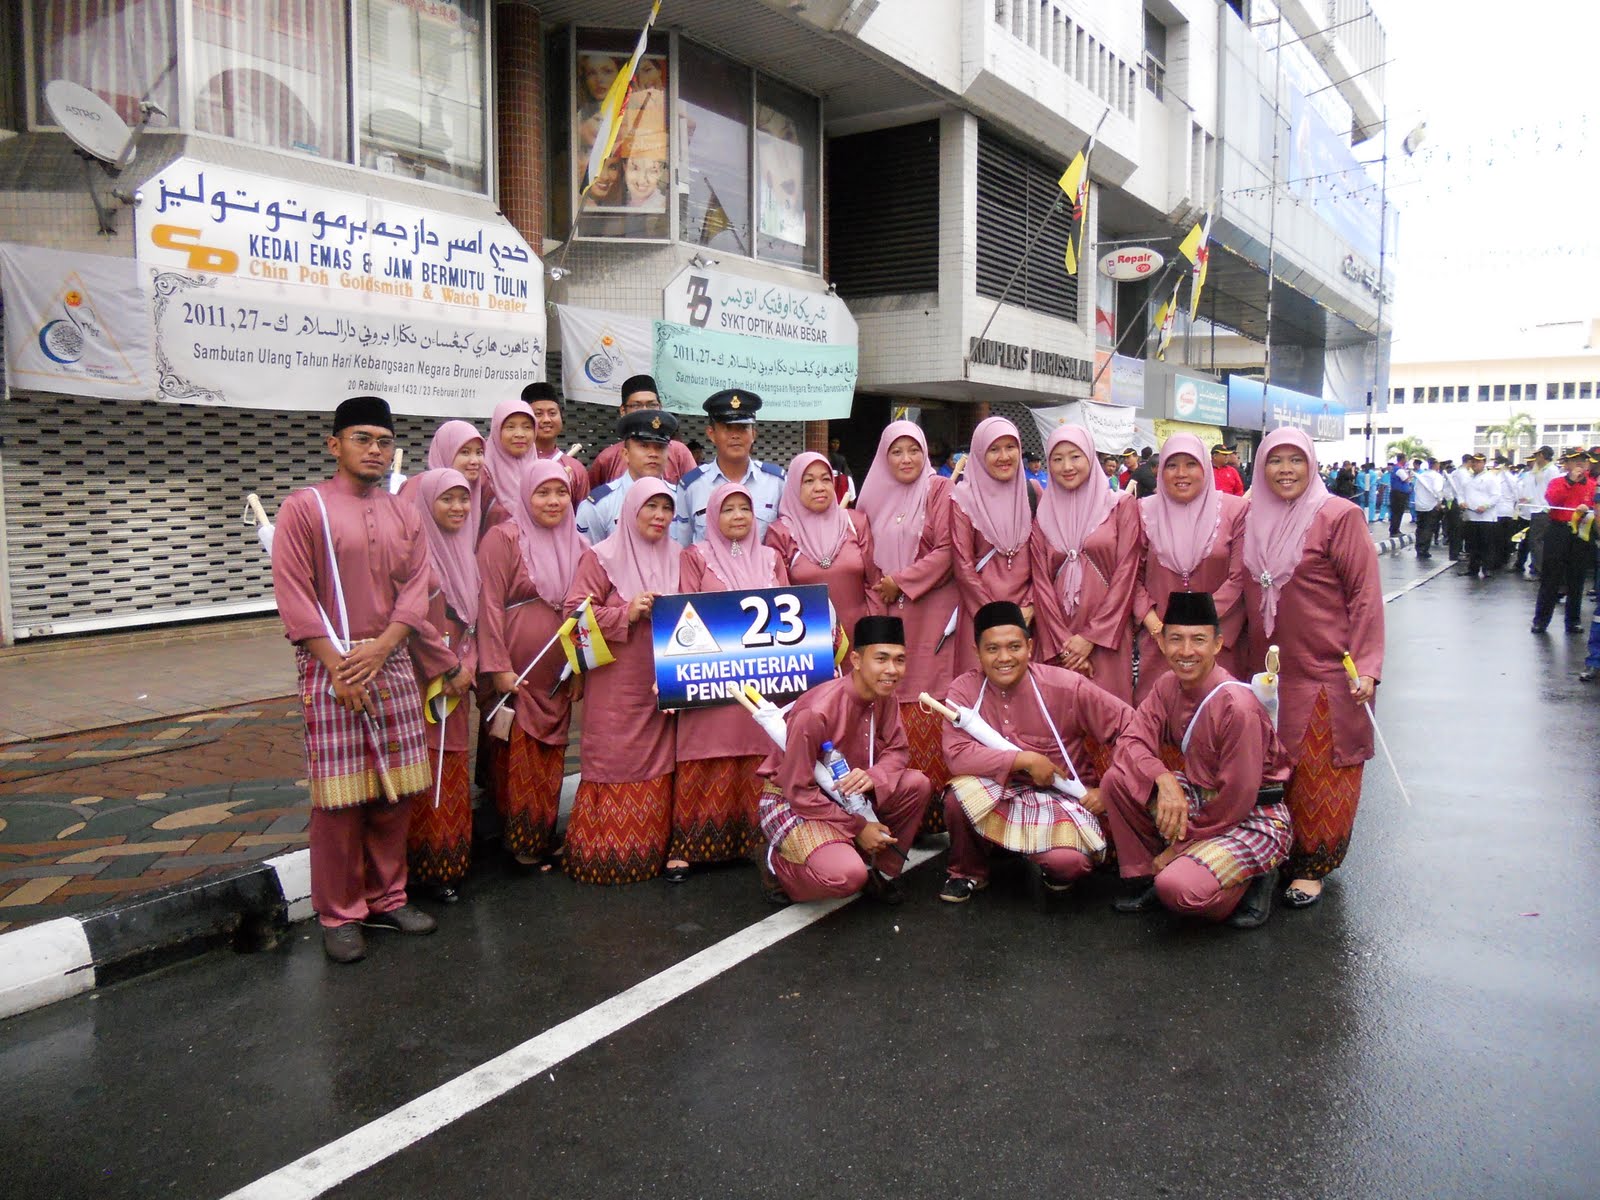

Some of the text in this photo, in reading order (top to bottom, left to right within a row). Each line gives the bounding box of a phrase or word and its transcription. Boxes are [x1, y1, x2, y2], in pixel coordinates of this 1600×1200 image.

[65, 105, 101, 121] ASTRO
[250, 234, 527, 299] KEDAI EMAS & JAM BERMUTU TULIN
[1117, 254, 1152, 264] Repair
[250, 260, 527, 313] Chin Poh Goldsmith & Watch Dealer
[720, 312, 745, 331] SYKT
[747, 316, 773, 334] OPTIK
[775, 321, 799, 340] ANAK
[801, 326, 828, 344] BESAR
[193, 342, 535, 381] Sambutan Ulang Tahun Hari Kebangsaan Negara Brunei Darussalam
[969, 336, 1093, 382] KOMPLEKS DARUSSALAM
[348, 380, 357, 391] 20
[358, 380, 400, 393] Rabiulawal
[402, 383, 417, 395] 1432
[423, 385, 431, 396] 23
[432, 386, 459, 398] Februari
[461, 388, 476, 399] 2011
[675, 371, 709, 386] Sambutan
[709, 376, 727, 390] Ulang
[728, 378, 744, 389] Tahun
[745, 380, 756, 391] Hari
[758, 381, 788, 395] Kebangsaan
[789, 383, 807, 395] Negara
[807, 383, 823, 393] Brunei
[739, 593, 806, 648] 23
[676, 653, 814, 682] KEMENTERIAN
